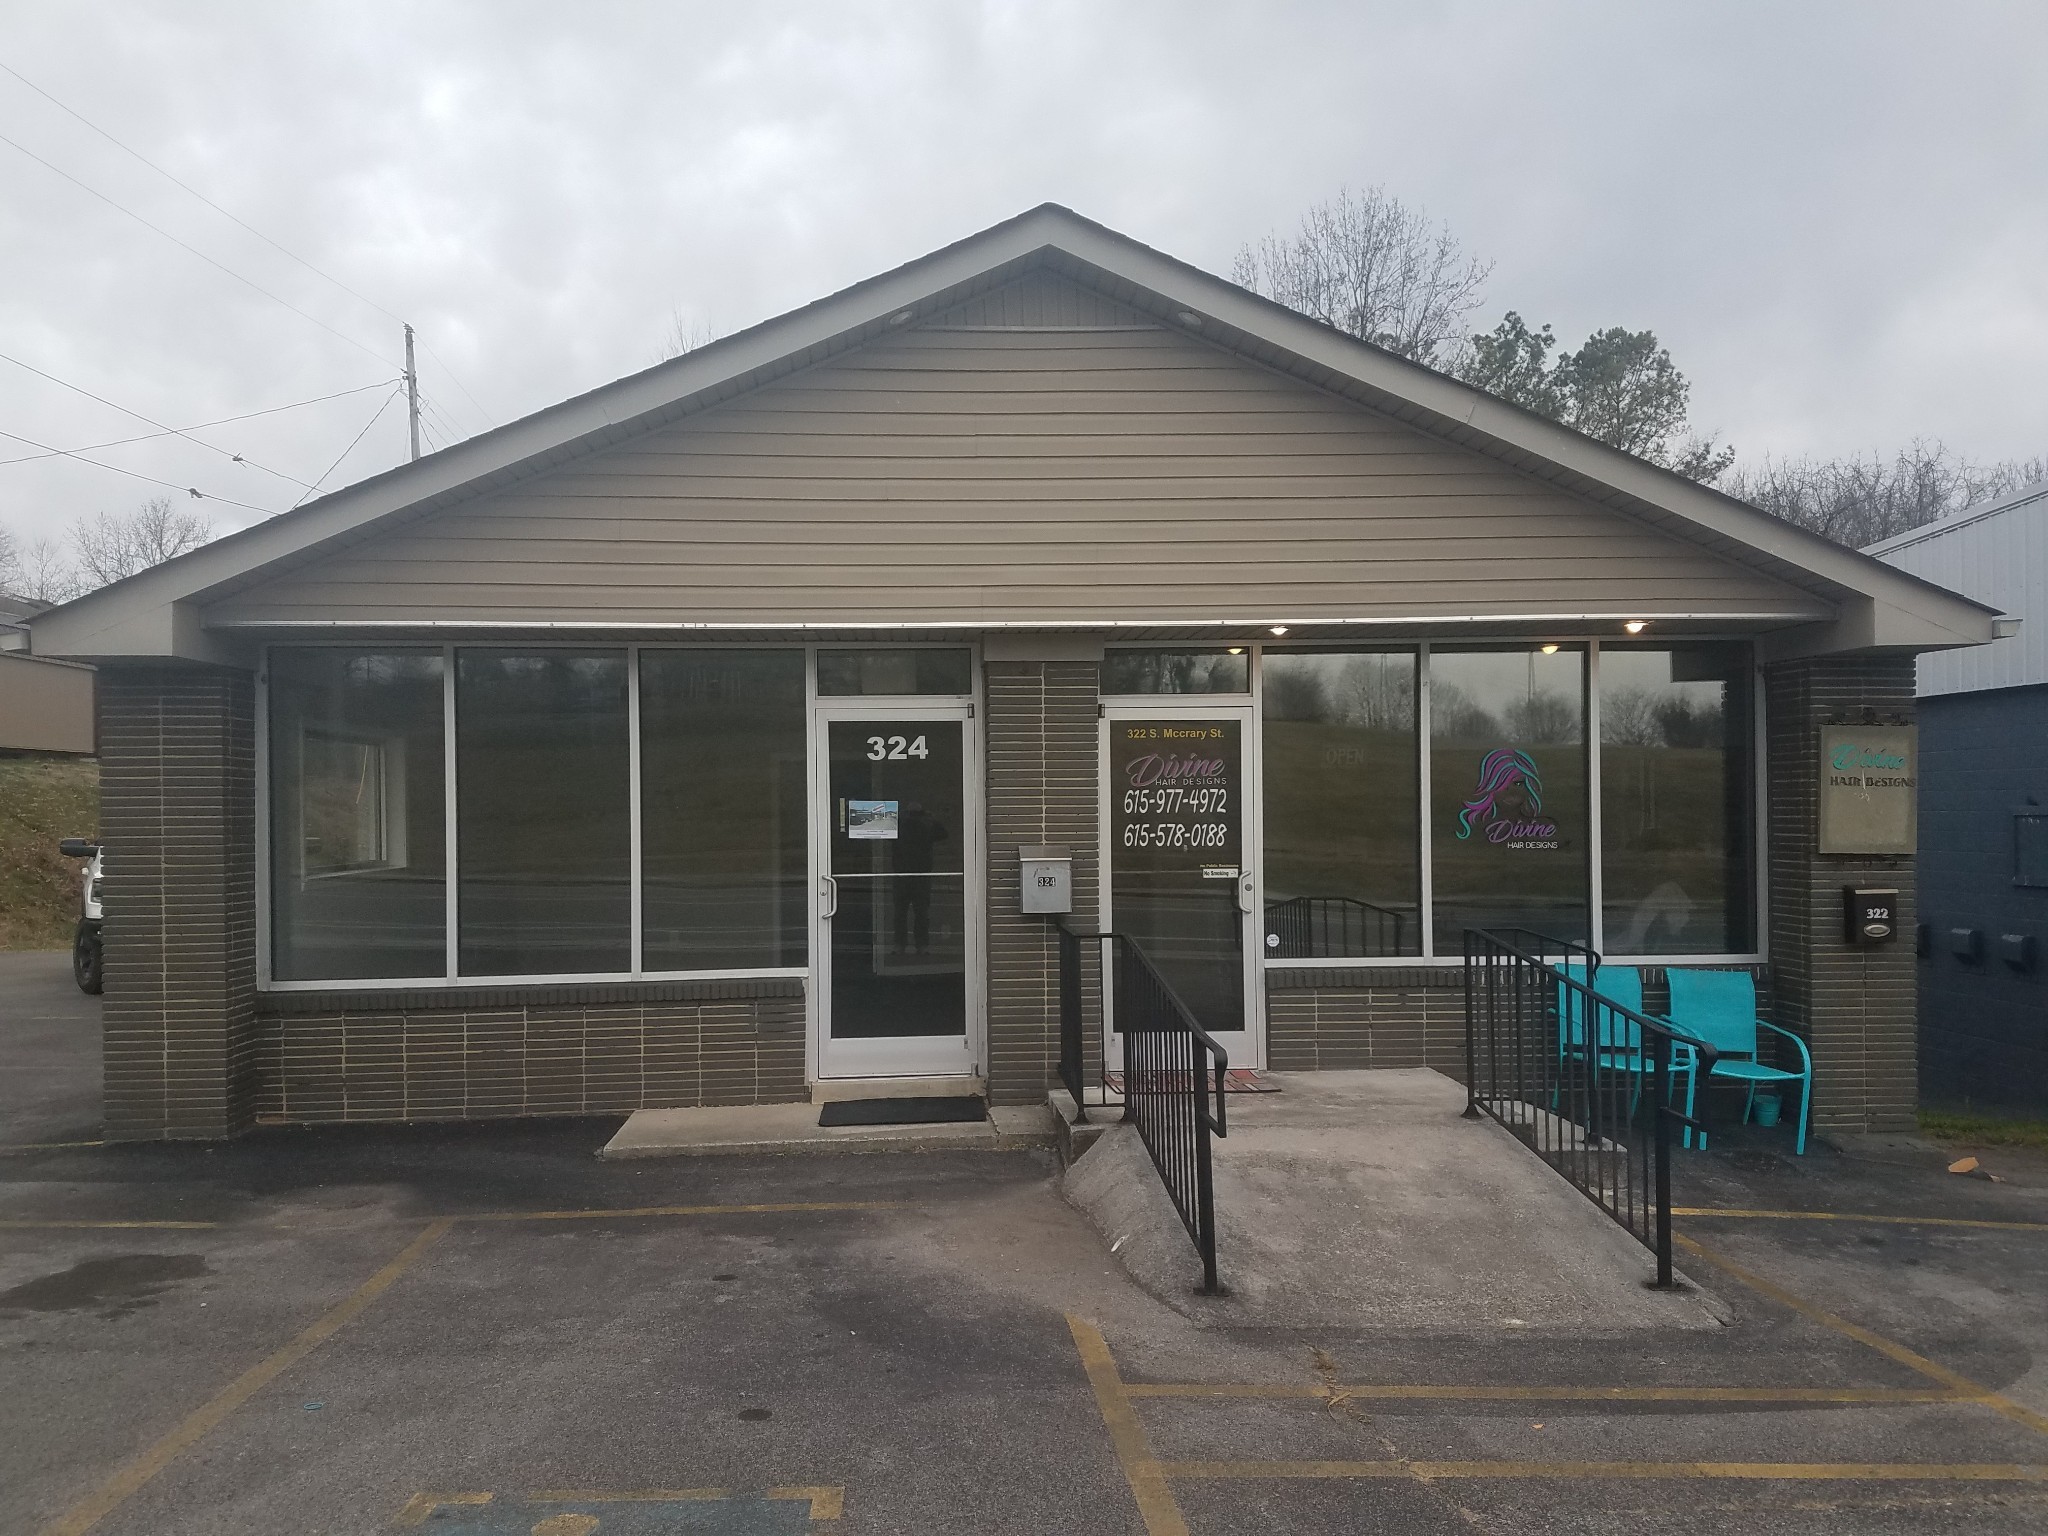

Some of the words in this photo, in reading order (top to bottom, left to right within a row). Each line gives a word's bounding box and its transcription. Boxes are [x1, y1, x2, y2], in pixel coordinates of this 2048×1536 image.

[1127, 729, 1146, 739] 322
[1150, 729, 1160, 738] S.
[1163, 728, 1207, 740] Mccrary
[1210, 728, 1225, 738] St.
[866, 735, 929, 761] 324
[1326, 748, 1365, 765] OPEN
[1126, 753, 1225, 787] Divine
[1155, 778, 1177, 786] HAIR
[1183, 777, 1227, 786] DESIGNS
[1829, 776, 1861, 787] HAIR
[1124, 789, 1227, 814] 615-977-4972
[1124, 823, 1227, 847] 615-578-0188
[1485, 820, 1556, 843] Divine
[1038, 877, 1056, 887] 324
[1866, 907, 1889, 919] 322
